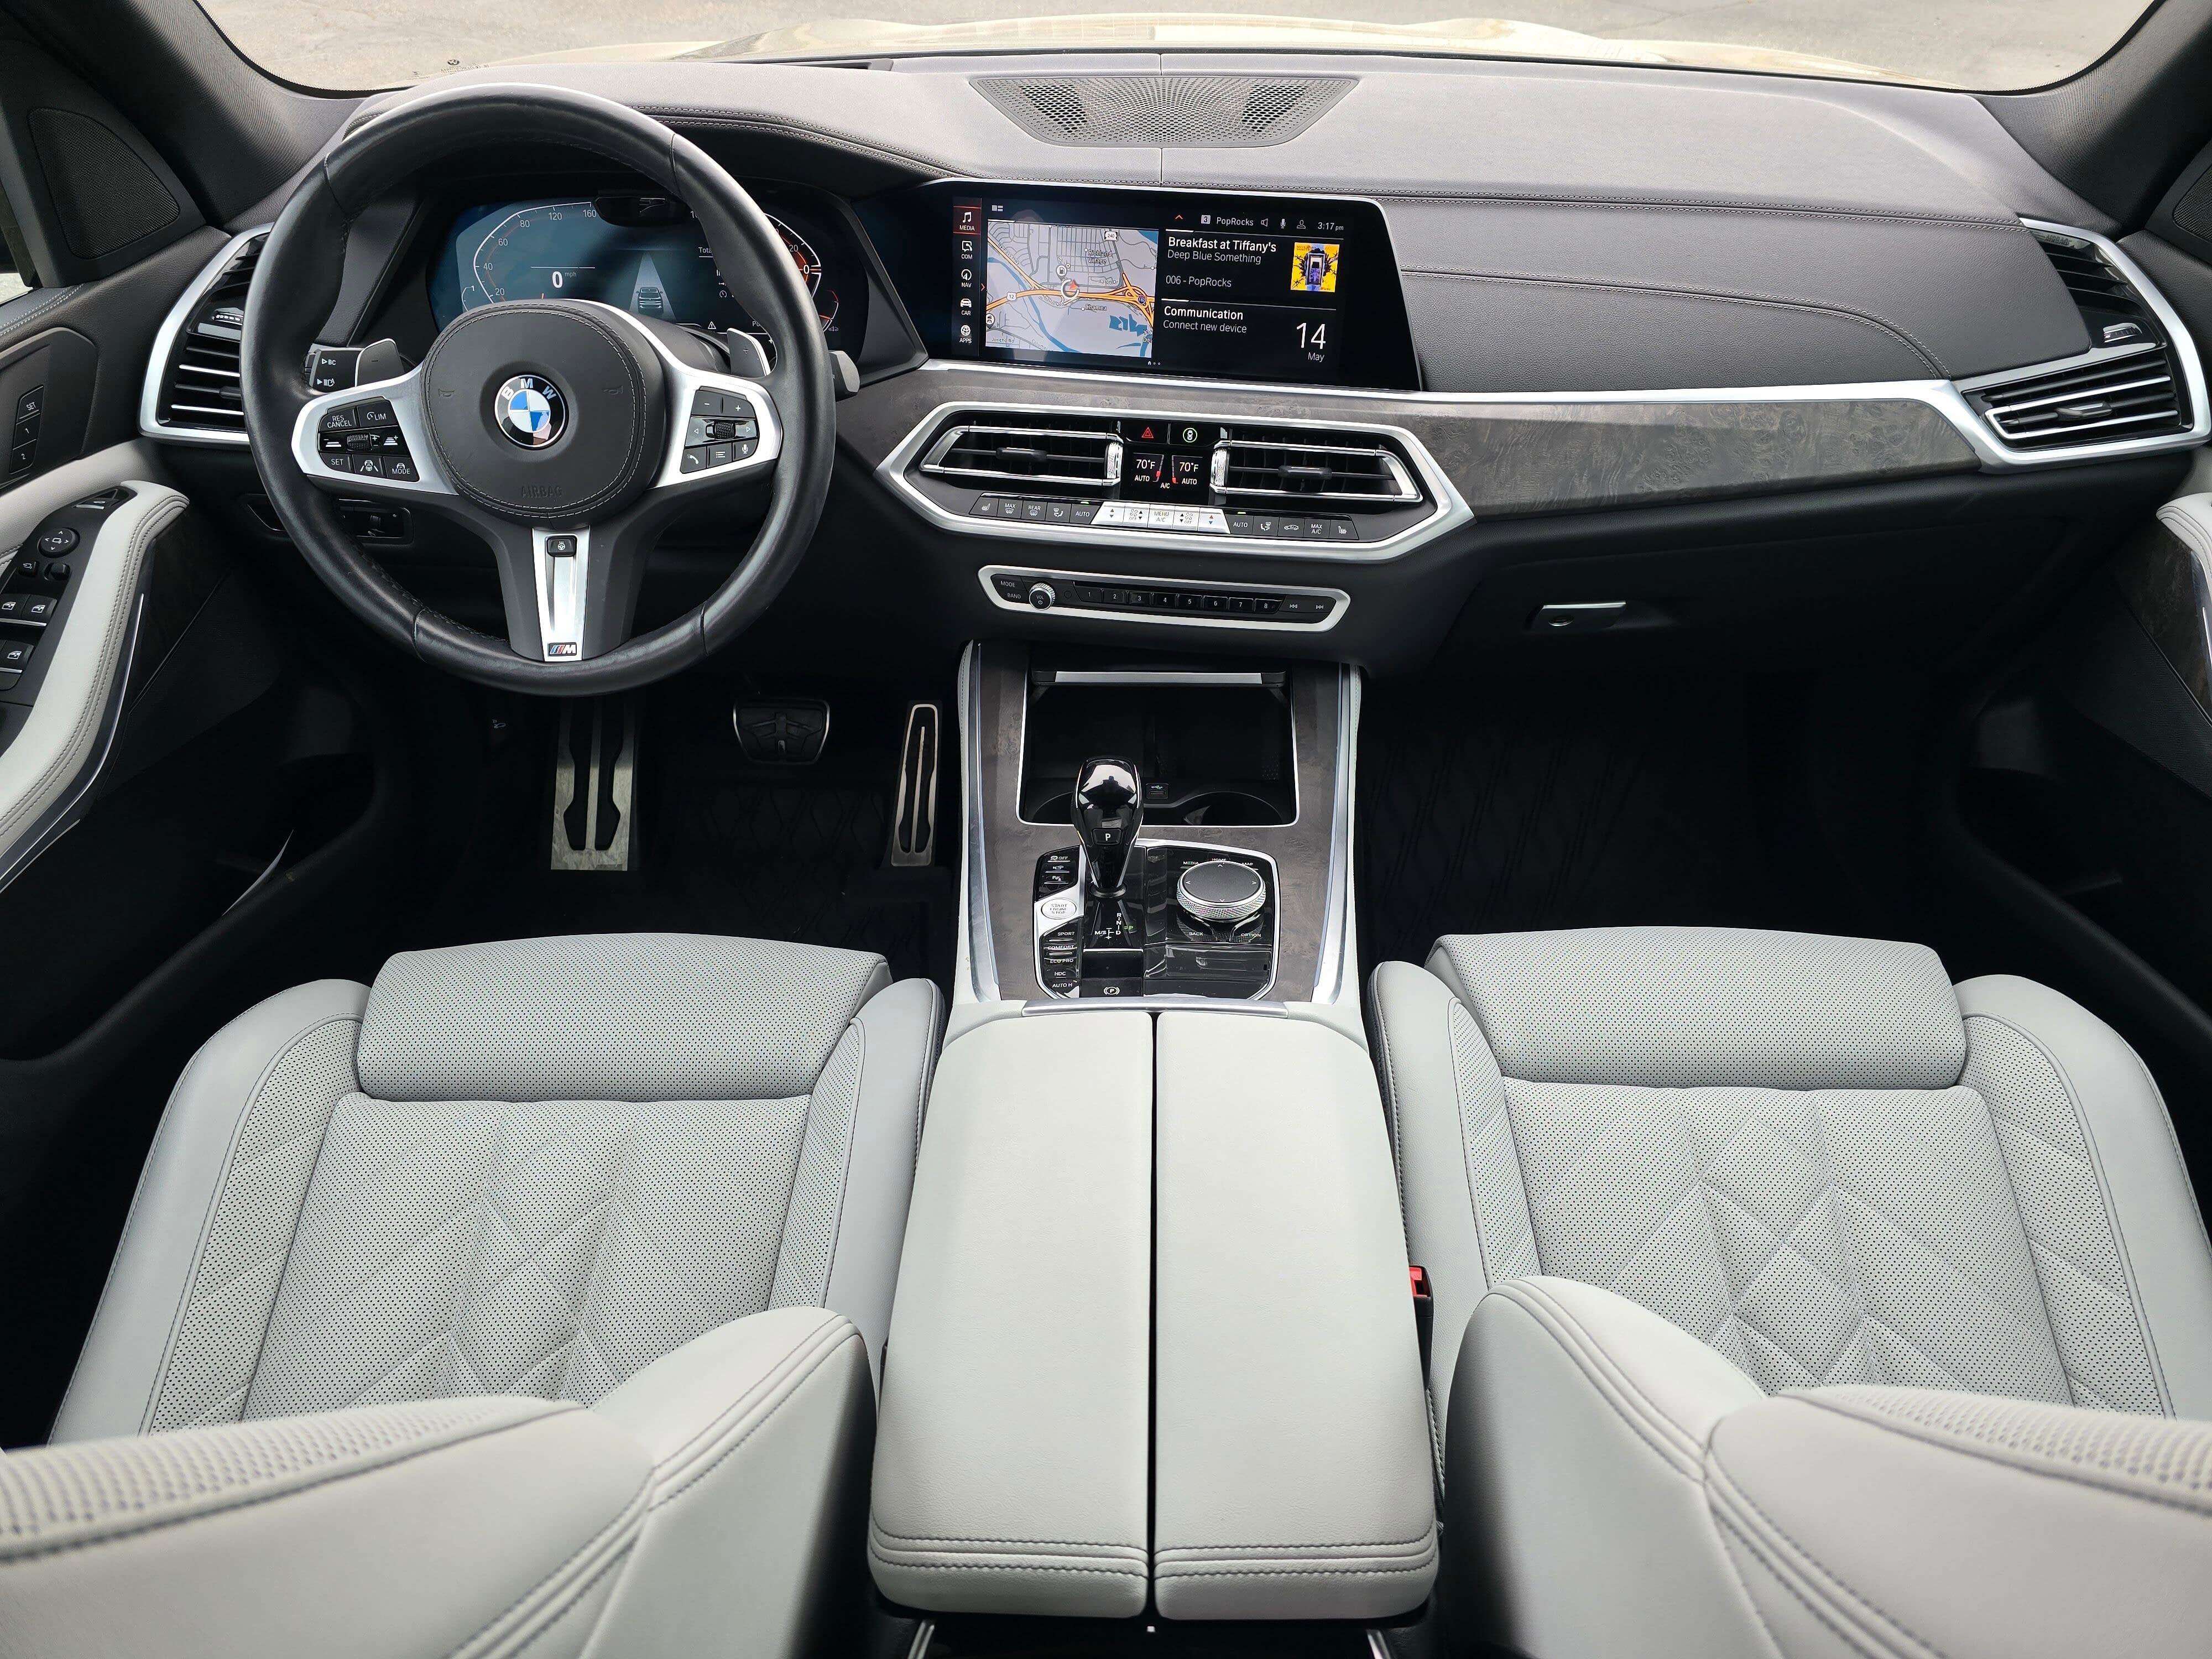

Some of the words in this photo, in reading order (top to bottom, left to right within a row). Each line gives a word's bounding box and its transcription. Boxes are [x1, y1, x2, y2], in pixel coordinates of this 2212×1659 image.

[548, 212, 562, 220] 120
[1216, 217, 1254, 226] PopRocks
[1317, 222, 1334, 231] 3:17
[1168, 237, 1218, 249] Breakfast
[1220, 241, 1230, 249] at
[1233, 240, 1276, 254] Tiffany's
[1167, 249, 1190, 260] Deep
[1192, 251, 1212, 260] Blue
[1214, 252, 1261, 265] Something
[803, 264, 810, 274] 0
[552, 271, 563, 288] 0
[1165, 275, 1181, 285] 006
[1188, 276, 1232, 288] PopRocks
[495, 288, 505, 296] 20
[1164, 306, 1244, 321] Communication
[1163, 320, 1198, 330] Connect
[1200, 323, 1217, 331] new
[1219, 323, 1247, 333] device
[1296, 322, 1326, 349] 14
[1307, 351, 1324, 363] May
[501, 378, 557, 400] BMW
[26, 401, 36, 411] SET
[327, 420, 352, 429] CANCEL
[521, 486, 562, 498] AIRBAG
[1105, 833, 1111, 841] P
